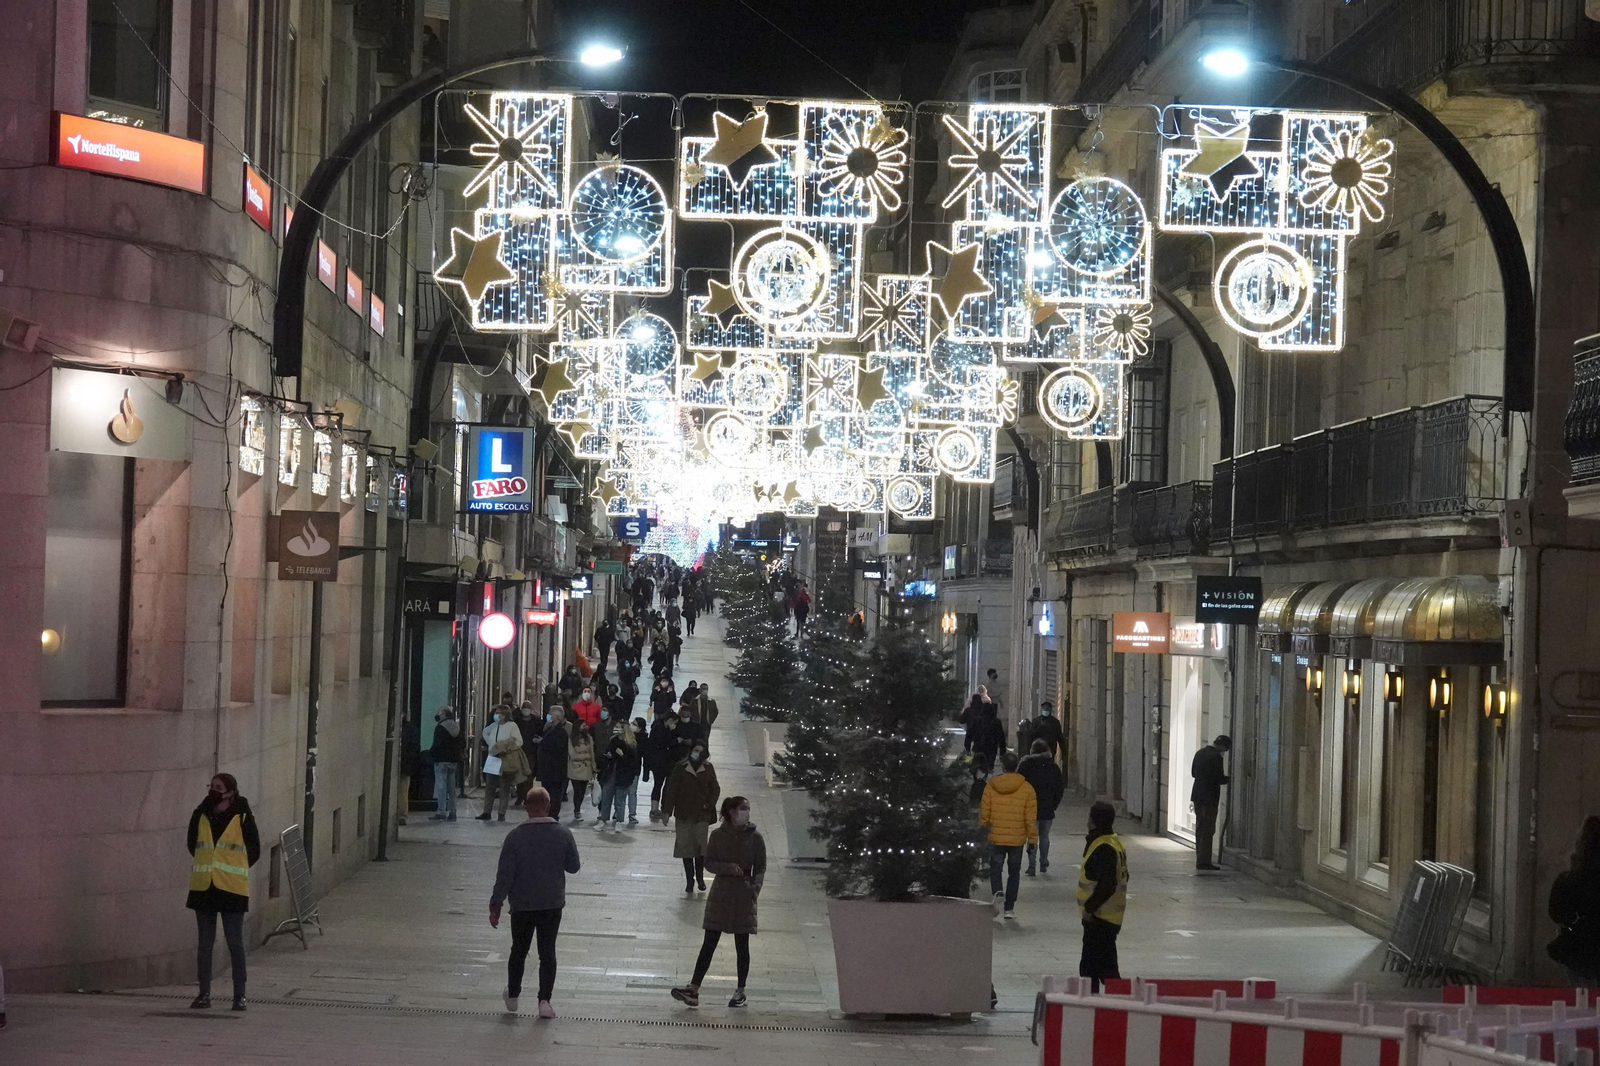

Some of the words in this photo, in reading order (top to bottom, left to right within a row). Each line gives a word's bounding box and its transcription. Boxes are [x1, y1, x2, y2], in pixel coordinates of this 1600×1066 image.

[81, 138, 140, 162] NorteHispana
[491, 437, 512, 473] L
[474, 477, 526, 497] FARO
[469, 502, 493, 510] AUTO
[494, 502, 529, 511] ESCOLAS
[625, 521, 640, 536] S
[295, 566, 331, 575] TELEBANCO
